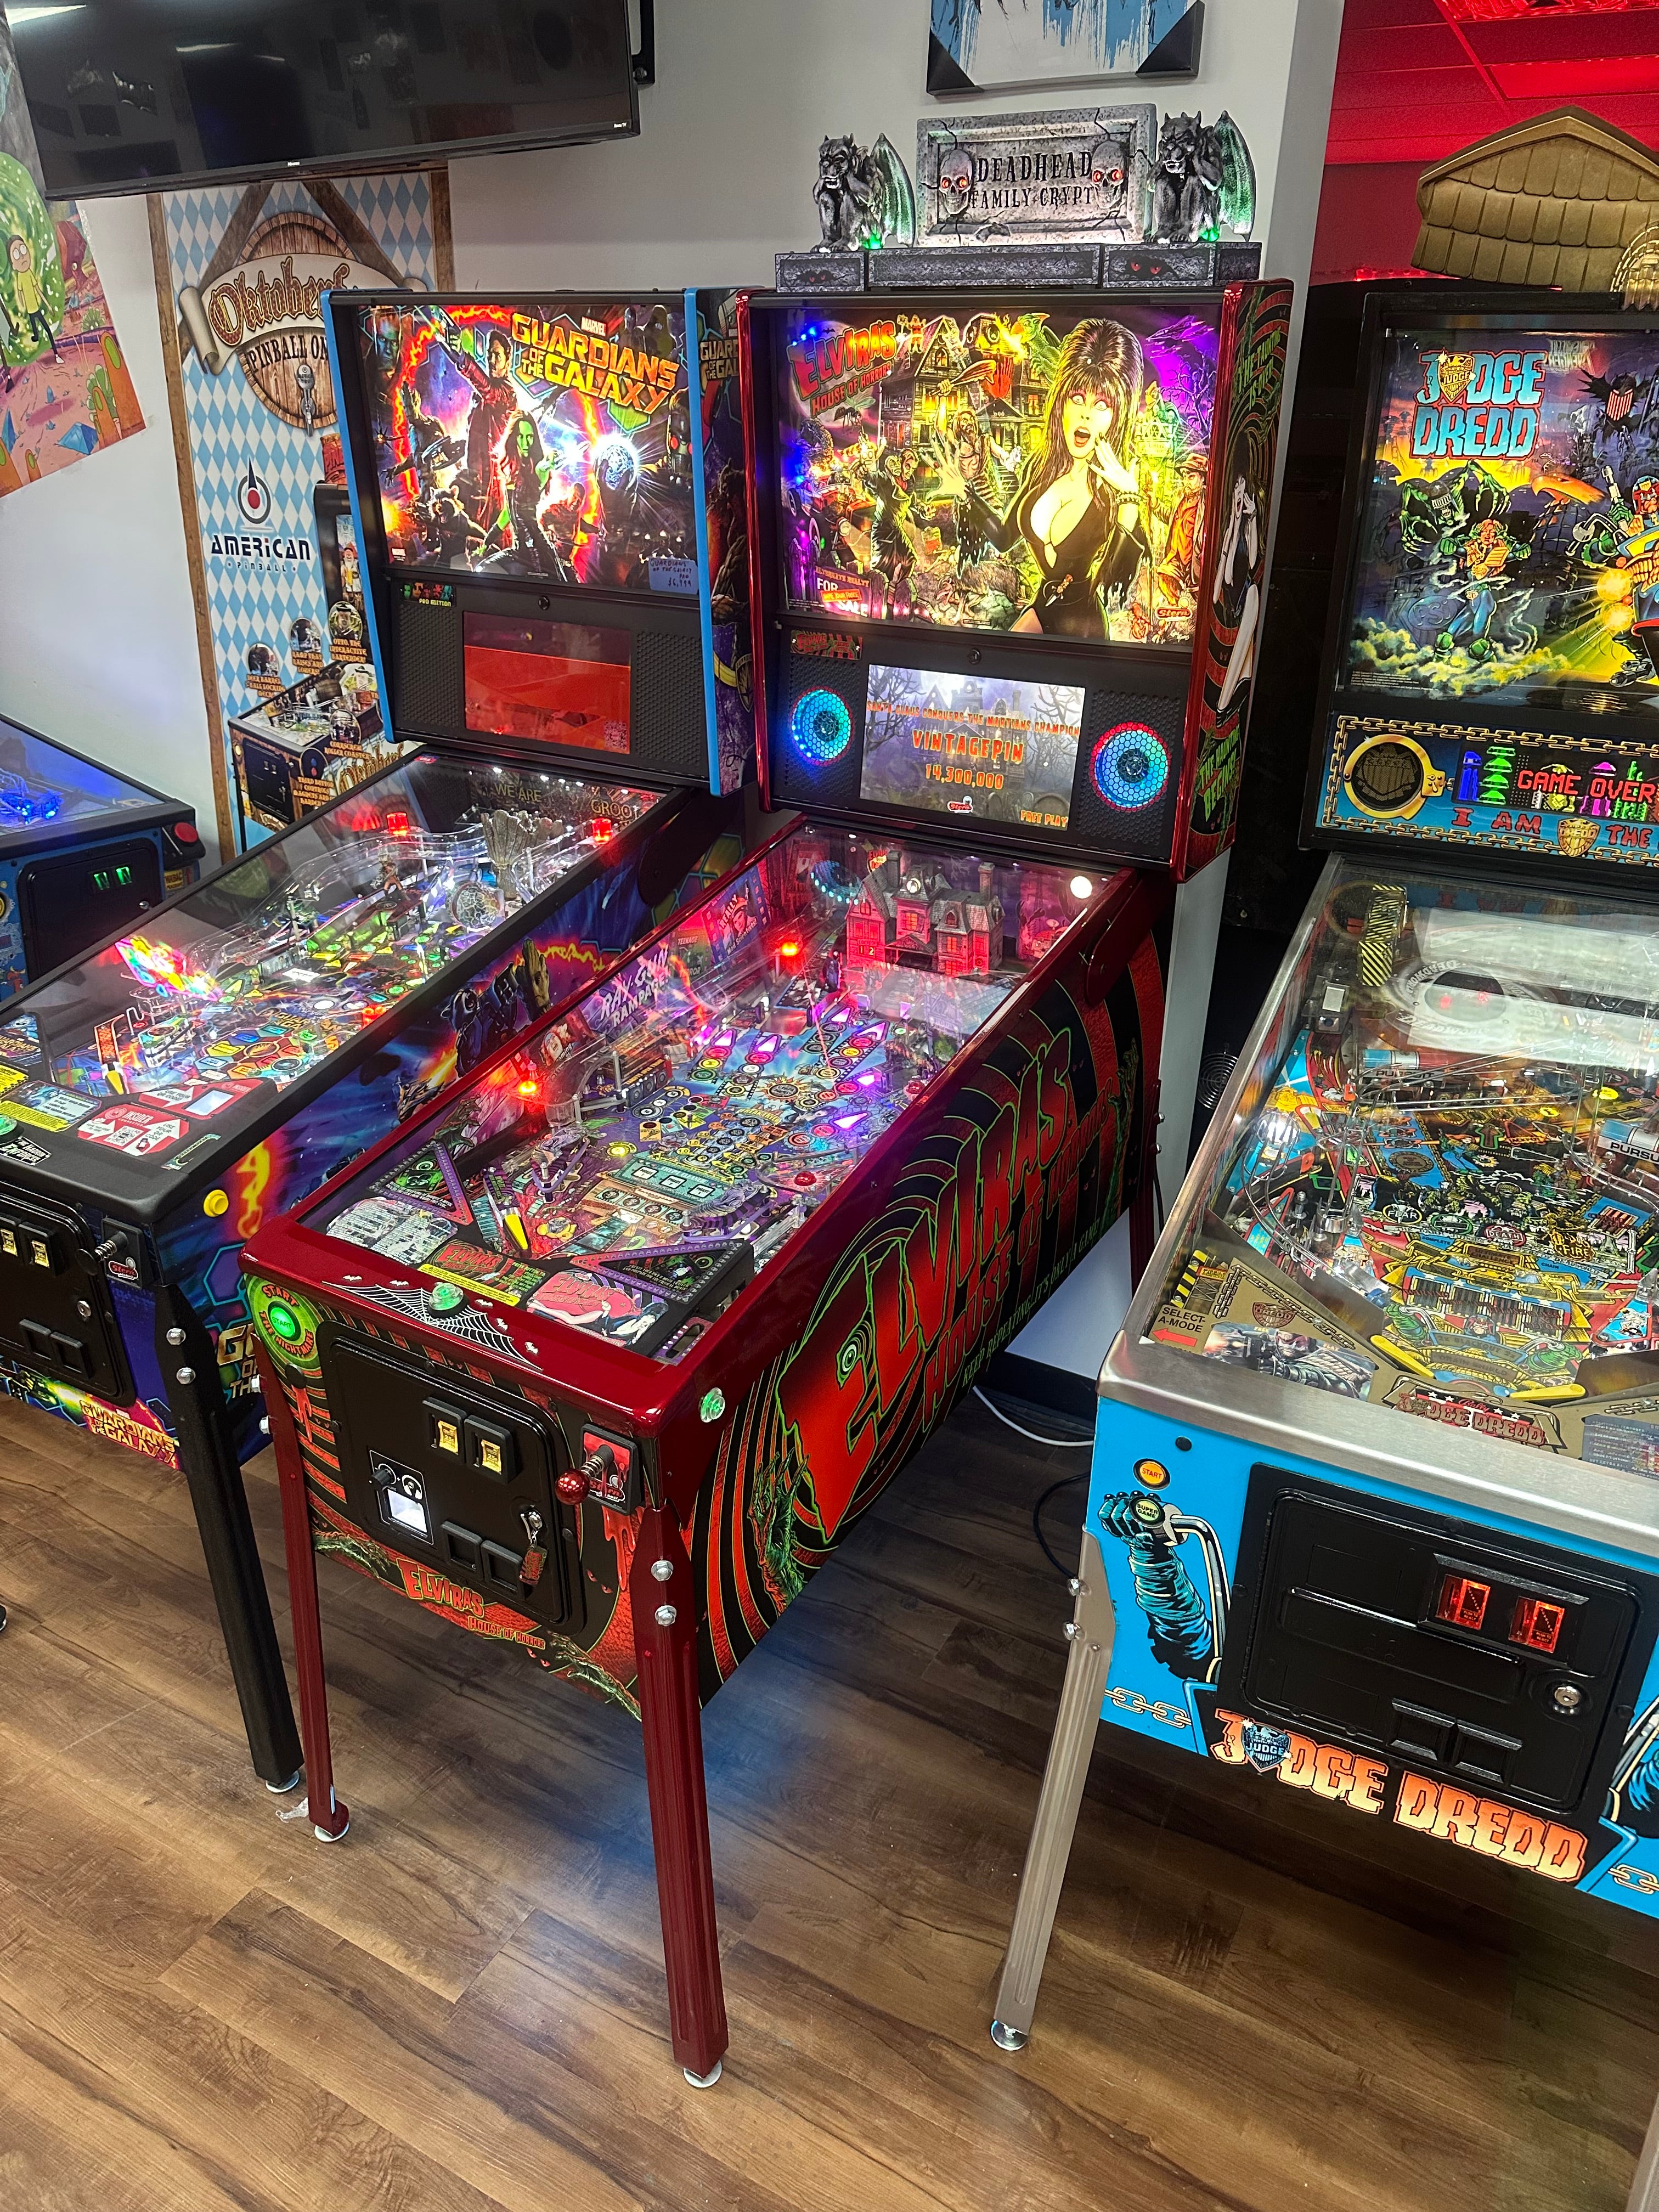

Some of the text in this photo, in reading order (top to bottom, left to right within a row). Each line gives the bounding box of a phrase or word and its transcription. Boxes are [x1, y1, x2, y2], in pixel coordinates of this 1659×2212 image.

[977, 151, 1092, 182] DEADHEAD
[972, 186, 1093, 209] FAMILY CRYPT
[582, 317, 606, 336] MARVEL
[248, 334, 307, 373] PINBALL
[512, 313, 679, 390] GUARDIANS
[529, 348, 546, 363] OF
[787, 320, 896, 400] ELVIRA'S
[706, 370, 716, 379] THE
[709, 360, 716, 369] OF
[1238, 352, 1255, 393] THE
[521, 353, 670, 414] THE GALAXY
[1442, 371, 1470, 385] JUDGE
[811, 362, 891, 416] HOUSE OF HORRORS
[1409, 404, 1542, 459] DREDD
[211, 535, 311, 560] AMERICAN
[817, 578, 838, 591] FOR
[838, 600, 868, 617] SALE
[866, 700, 1079, 736] SANTA CLAUS CONQUERS THE MARTIANS CHAMPION
[324, 747, 344, 757] ROLLER
[912, 730, 1024, 765] VINTAGEPIN
[925, 763, 1004, 790] 14,300,000
[1517, 770, 1657, 803] GAME OVER
[495, 783, 542, 803] WE ARE
[1020, 810, 1068, 827] FREE PLAY
[1452, 806, 1653, 849] I AM THE
[1559, 829, 1598, 838] DREDD
[719, 894, 739, 928] REALLY
[678, 935, 698, 945] TEENAGE
[868, 947, 874, 956] 2
[600, 944, 668, 1021] RAY-GUN
[613, 965, 670, 1028] RAMPAGE!
[1376, 1070, 1436, 1079] PURSUIT
[232, 1084, 251, 1093] INSIDER
[123, 1110, 154, 1124] INSIDER
[1387, 1210, 1418, 1220] FEAR
[1422, 1235, 1451, 1245] COMPLETE
[1488, 1231, 1522, 1241] DEATH
[1562, 1244, 1591, 1256] FIRE
[111, 1264, 136, 1276] Stern
[262, 1284, 300, 1307] START
[777, 1028, 1073, 1542] ELVIRA'S
[923, 1231, 1014, 1431] HOUSE
[1017, 1180, 1044, 1265] OF
[1162, 1306, 1205, 1324] SELECT-
[258, 1310, 276, 1336] THE
[272, 1316, 292, 1330] START
[962, 1348, 985, 1388] KEEP
[1050, 1256, 1070, 1285] ONLY
[1158, 1316, 1203, 1333] A-MODE
[274, 1328, 314, 1356] NIGHTMARE
[1453, 1336, 1500, 1353] BLACKOUT
[1458, 1398, 1490, 1413] Bally
[80, 1400, 176, 1453] GUARDIANS
[1472, 1413, 1545, 1447] DREDD
[104, 1423, 175, 1464] GALAXY
[1142, 1468, 1163, 1480] START
[1137, 1503, 1159, 1515] SUPER
[1138, 1509, 1156, 1519] GAME
[396, 1558, 485, 1618] ELVIRA'S
[468, 1616, 546, 1650] HOUSE OF HORRORS
[1246, 1741, 1285, 1756] JUDGE
[1393, 1770, 1588, 1883] DREDD
